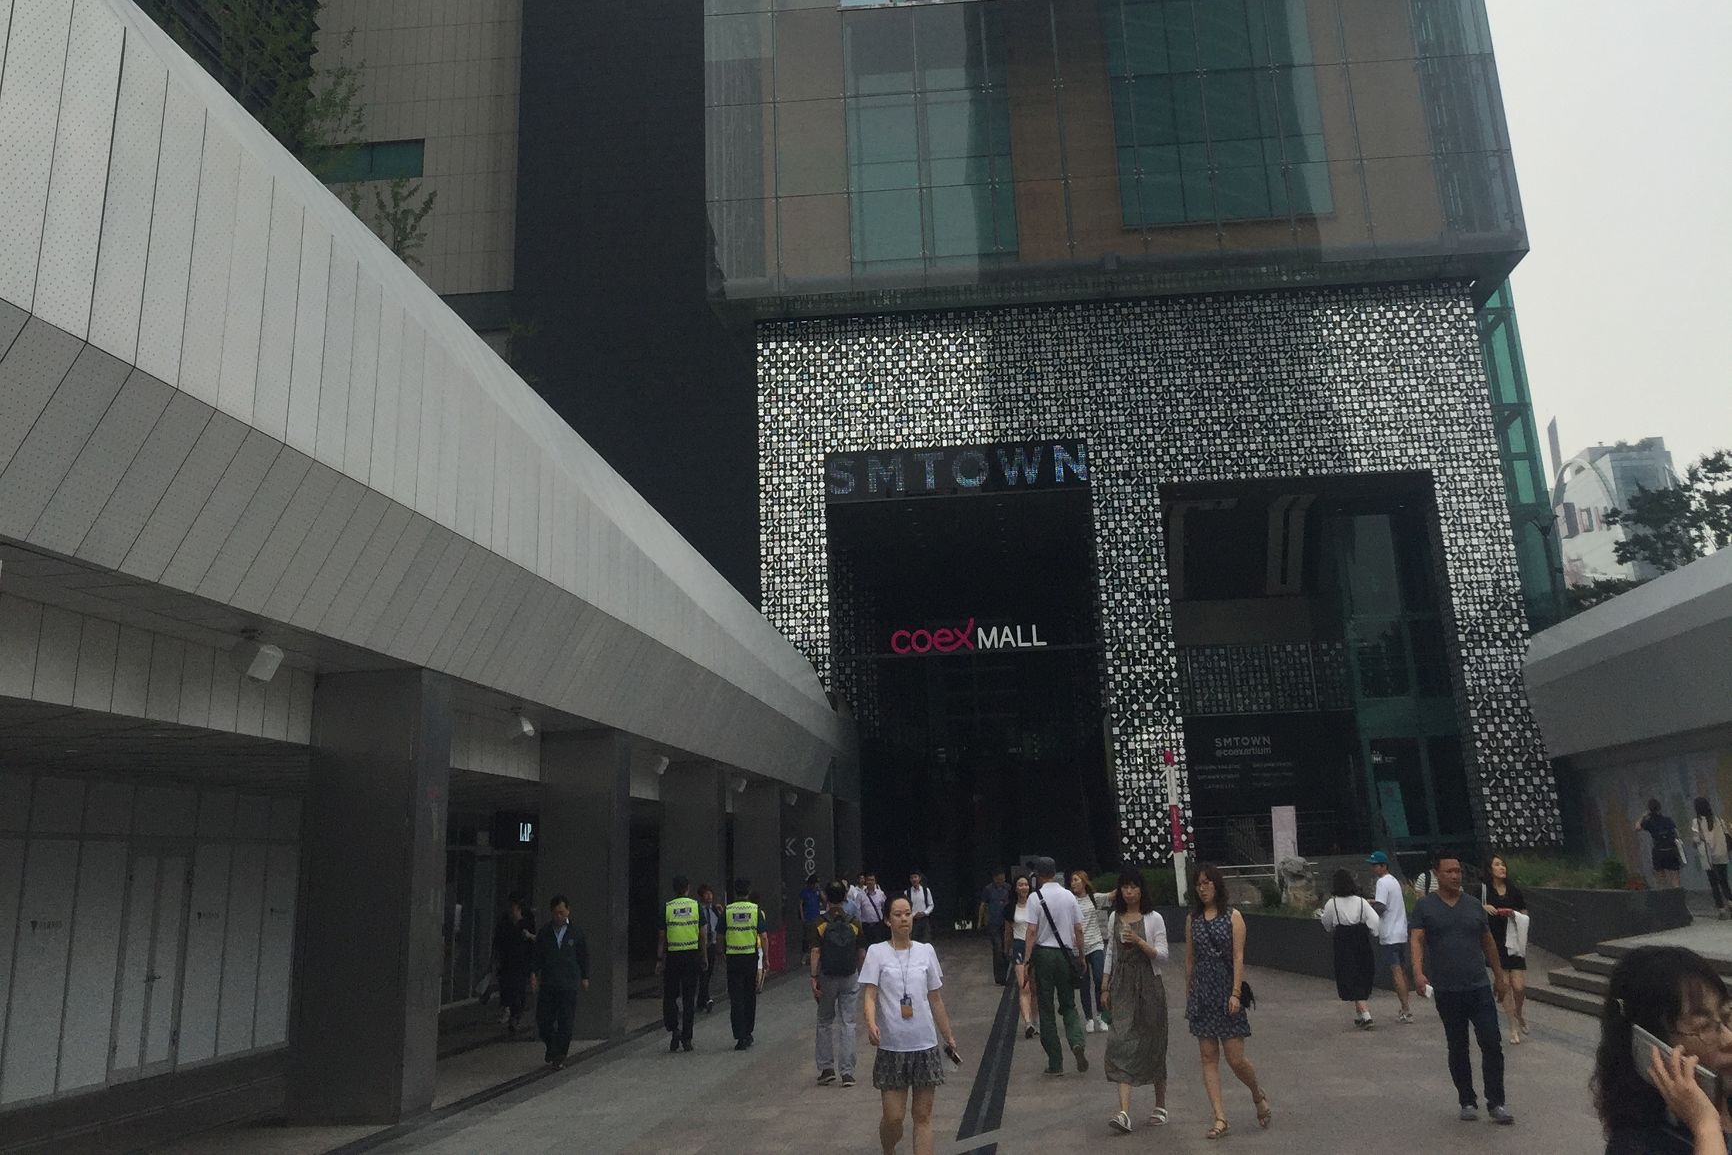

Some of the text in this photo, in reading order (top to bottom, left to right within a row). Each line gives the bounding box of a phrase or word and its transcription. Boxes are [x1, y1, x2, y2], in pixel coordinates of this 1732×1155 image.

[829, 443, 1088, 495] SMTOWN
[890, 616, 1047, 653] coex MALL
[1214, 735, 1272, 748] SMTOWN
